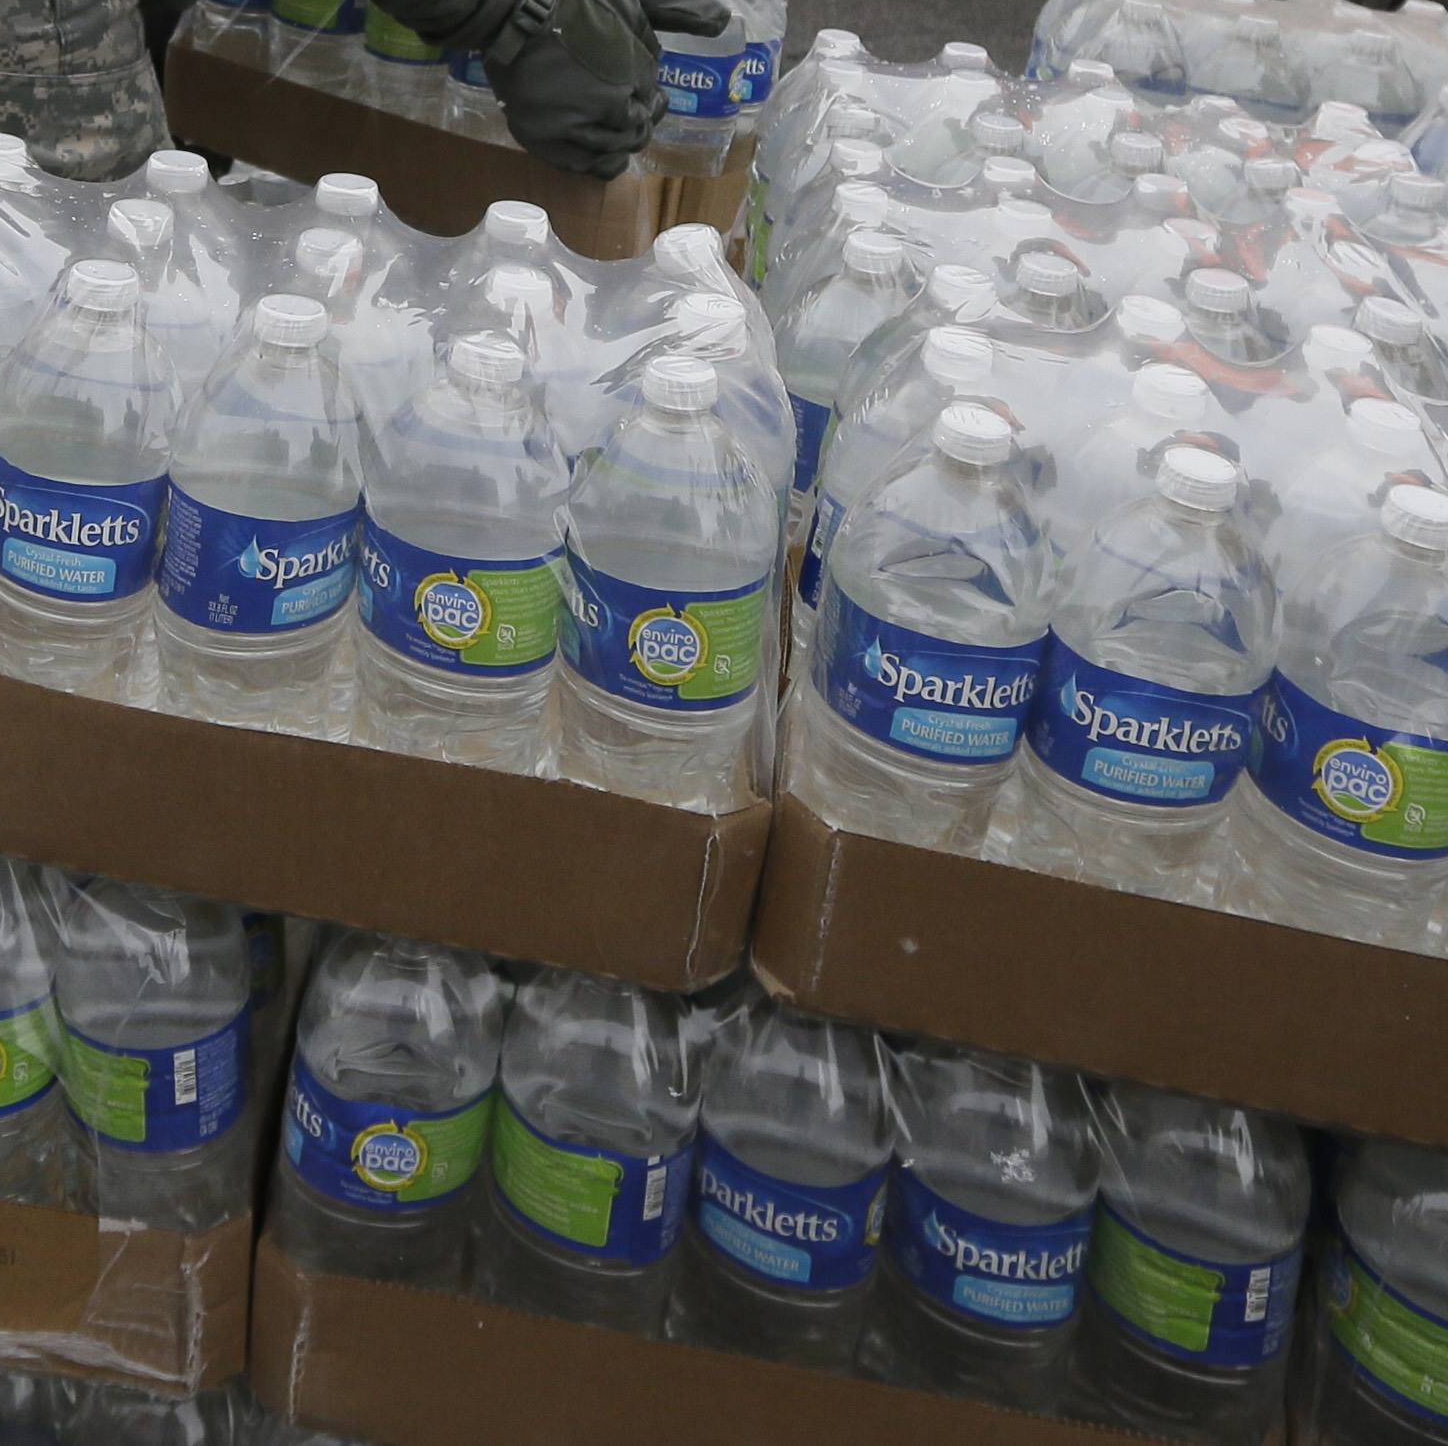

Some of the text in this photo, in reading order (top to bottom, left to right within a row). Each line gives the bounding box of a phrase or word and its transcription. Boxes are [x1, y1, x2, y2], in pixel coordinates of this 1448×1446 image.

[8, 548, 106, 584] PURIFIED WATER
[427, 591, 477, 612] enviro
[427, 604, 479, 629] pac
[642, 628, 694, 646] enviro
[643, 639, 697, 663] pac
[877, 652, 1038, 710] Sparkletts
[902, 718, 1010, 746] PURIFIED WATER
[1071, 690, 1242, 755] Sparkletts
[1093, 760, 1206, 789] PURIFIED WATER
[1328, 757, 1388, 784] enviro
[1327, 768, 1389, 803] pac
[365, 1142, 415, 1157] enviro
[365, 1153, 416, 1173] pac
[702, 1166, 838, 1243] parkletts
[754, 1249, 800, 1273] WATER
[937, 1225, 1085, 1281] Sparklett
[962, 1285, 1069, 1313] PURIFIED WATER
